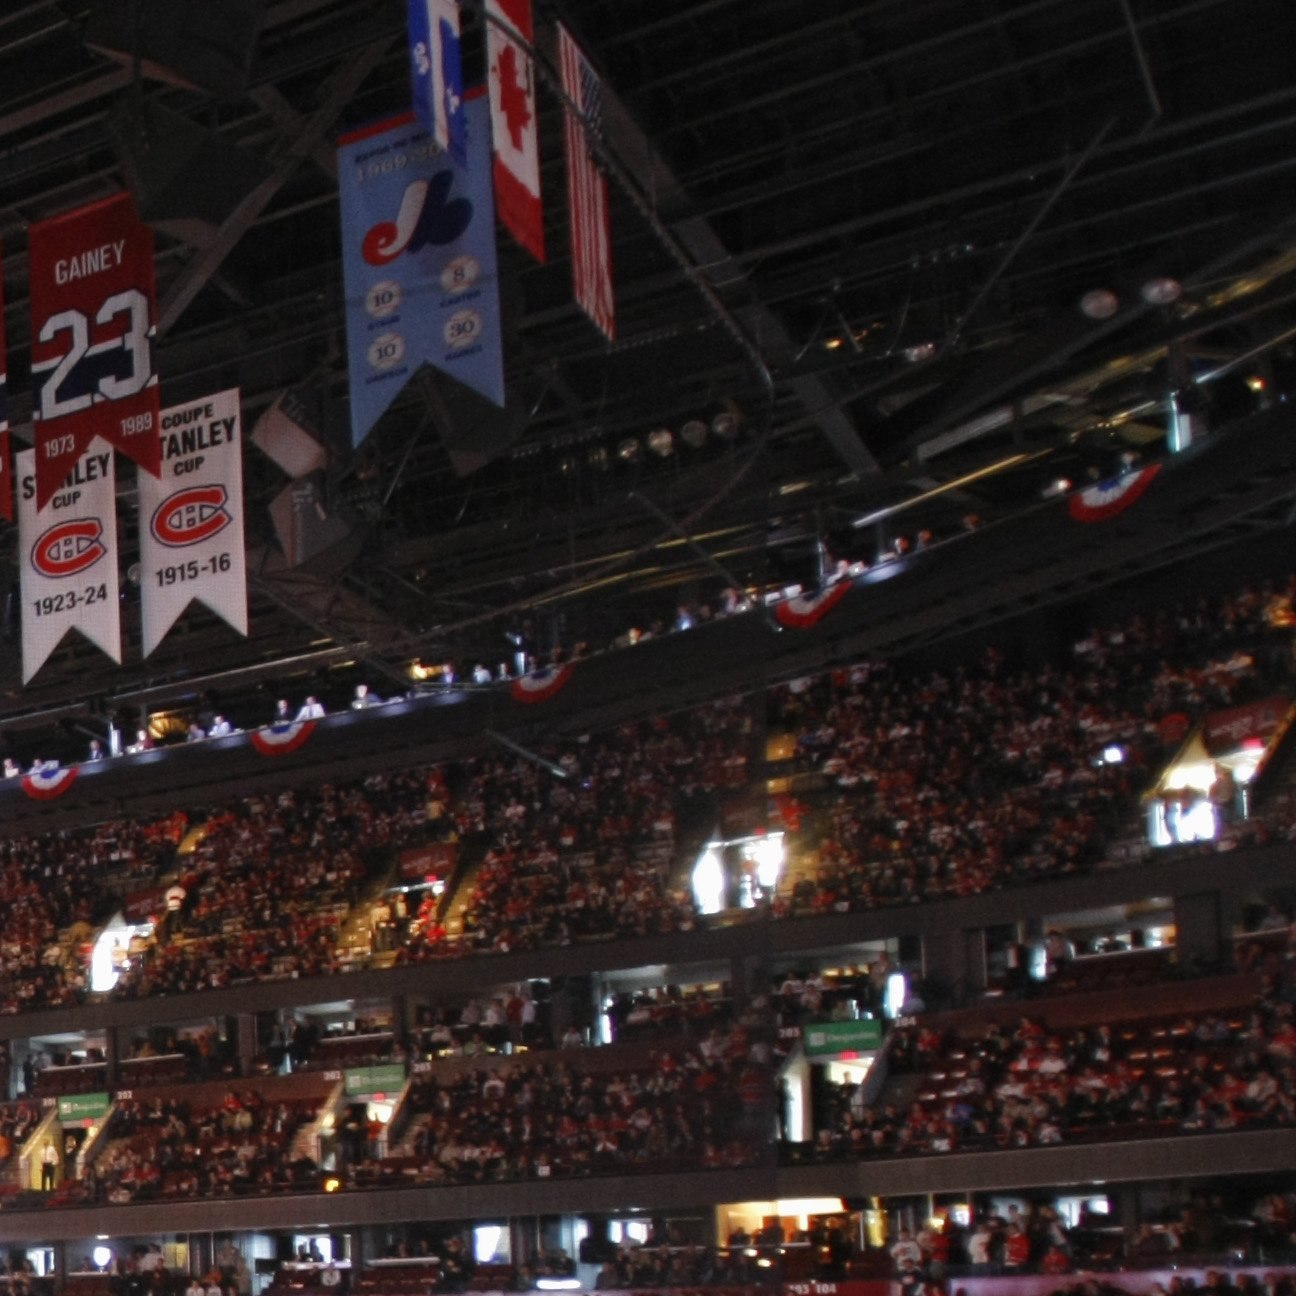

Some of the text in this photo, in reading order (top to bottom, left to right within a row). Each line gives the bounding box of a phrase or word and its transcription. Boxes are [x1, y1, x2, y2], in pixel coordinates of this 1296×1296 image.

[54, 239, 125, 287] GAINEY
[38, 288, 152, 422] 23
[161, 403, 214, 430] COUPE
[44, 411, 153, 459] 1973 1989
[173, 456, 205, 477] CUP
[52, 490, 82, 510] CUP
[155, 552, 232, 587] 1915-16
[33, 583, 108, 617] 1923-24
